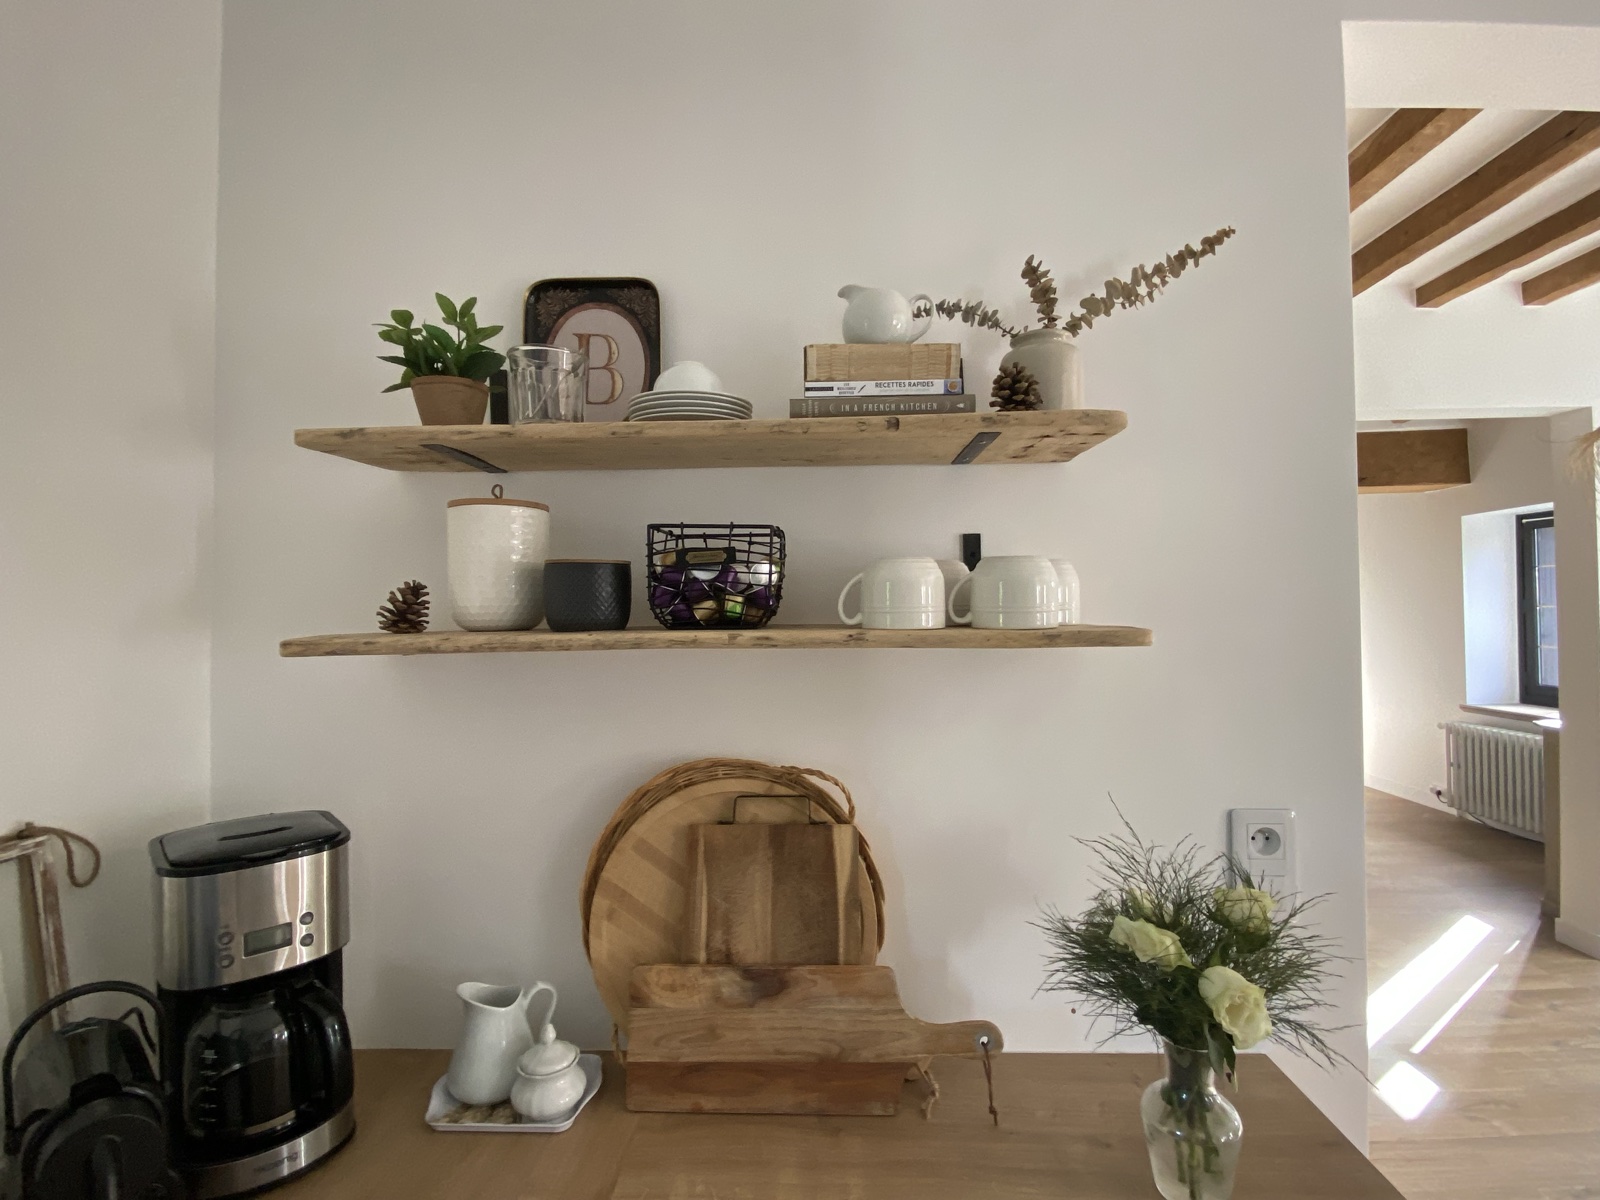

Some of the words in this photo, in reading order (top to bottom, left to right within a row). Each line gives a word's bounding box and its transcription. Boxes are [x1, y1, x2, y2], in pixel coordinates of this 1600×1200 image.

[572, 333, 624, 405] B
[841, 404, 850, 412] IN
[853, 404, 858, 412] A
[863, 403, 896, 412] FRENCH
[900, 402, 937, 411] KITCHEN
